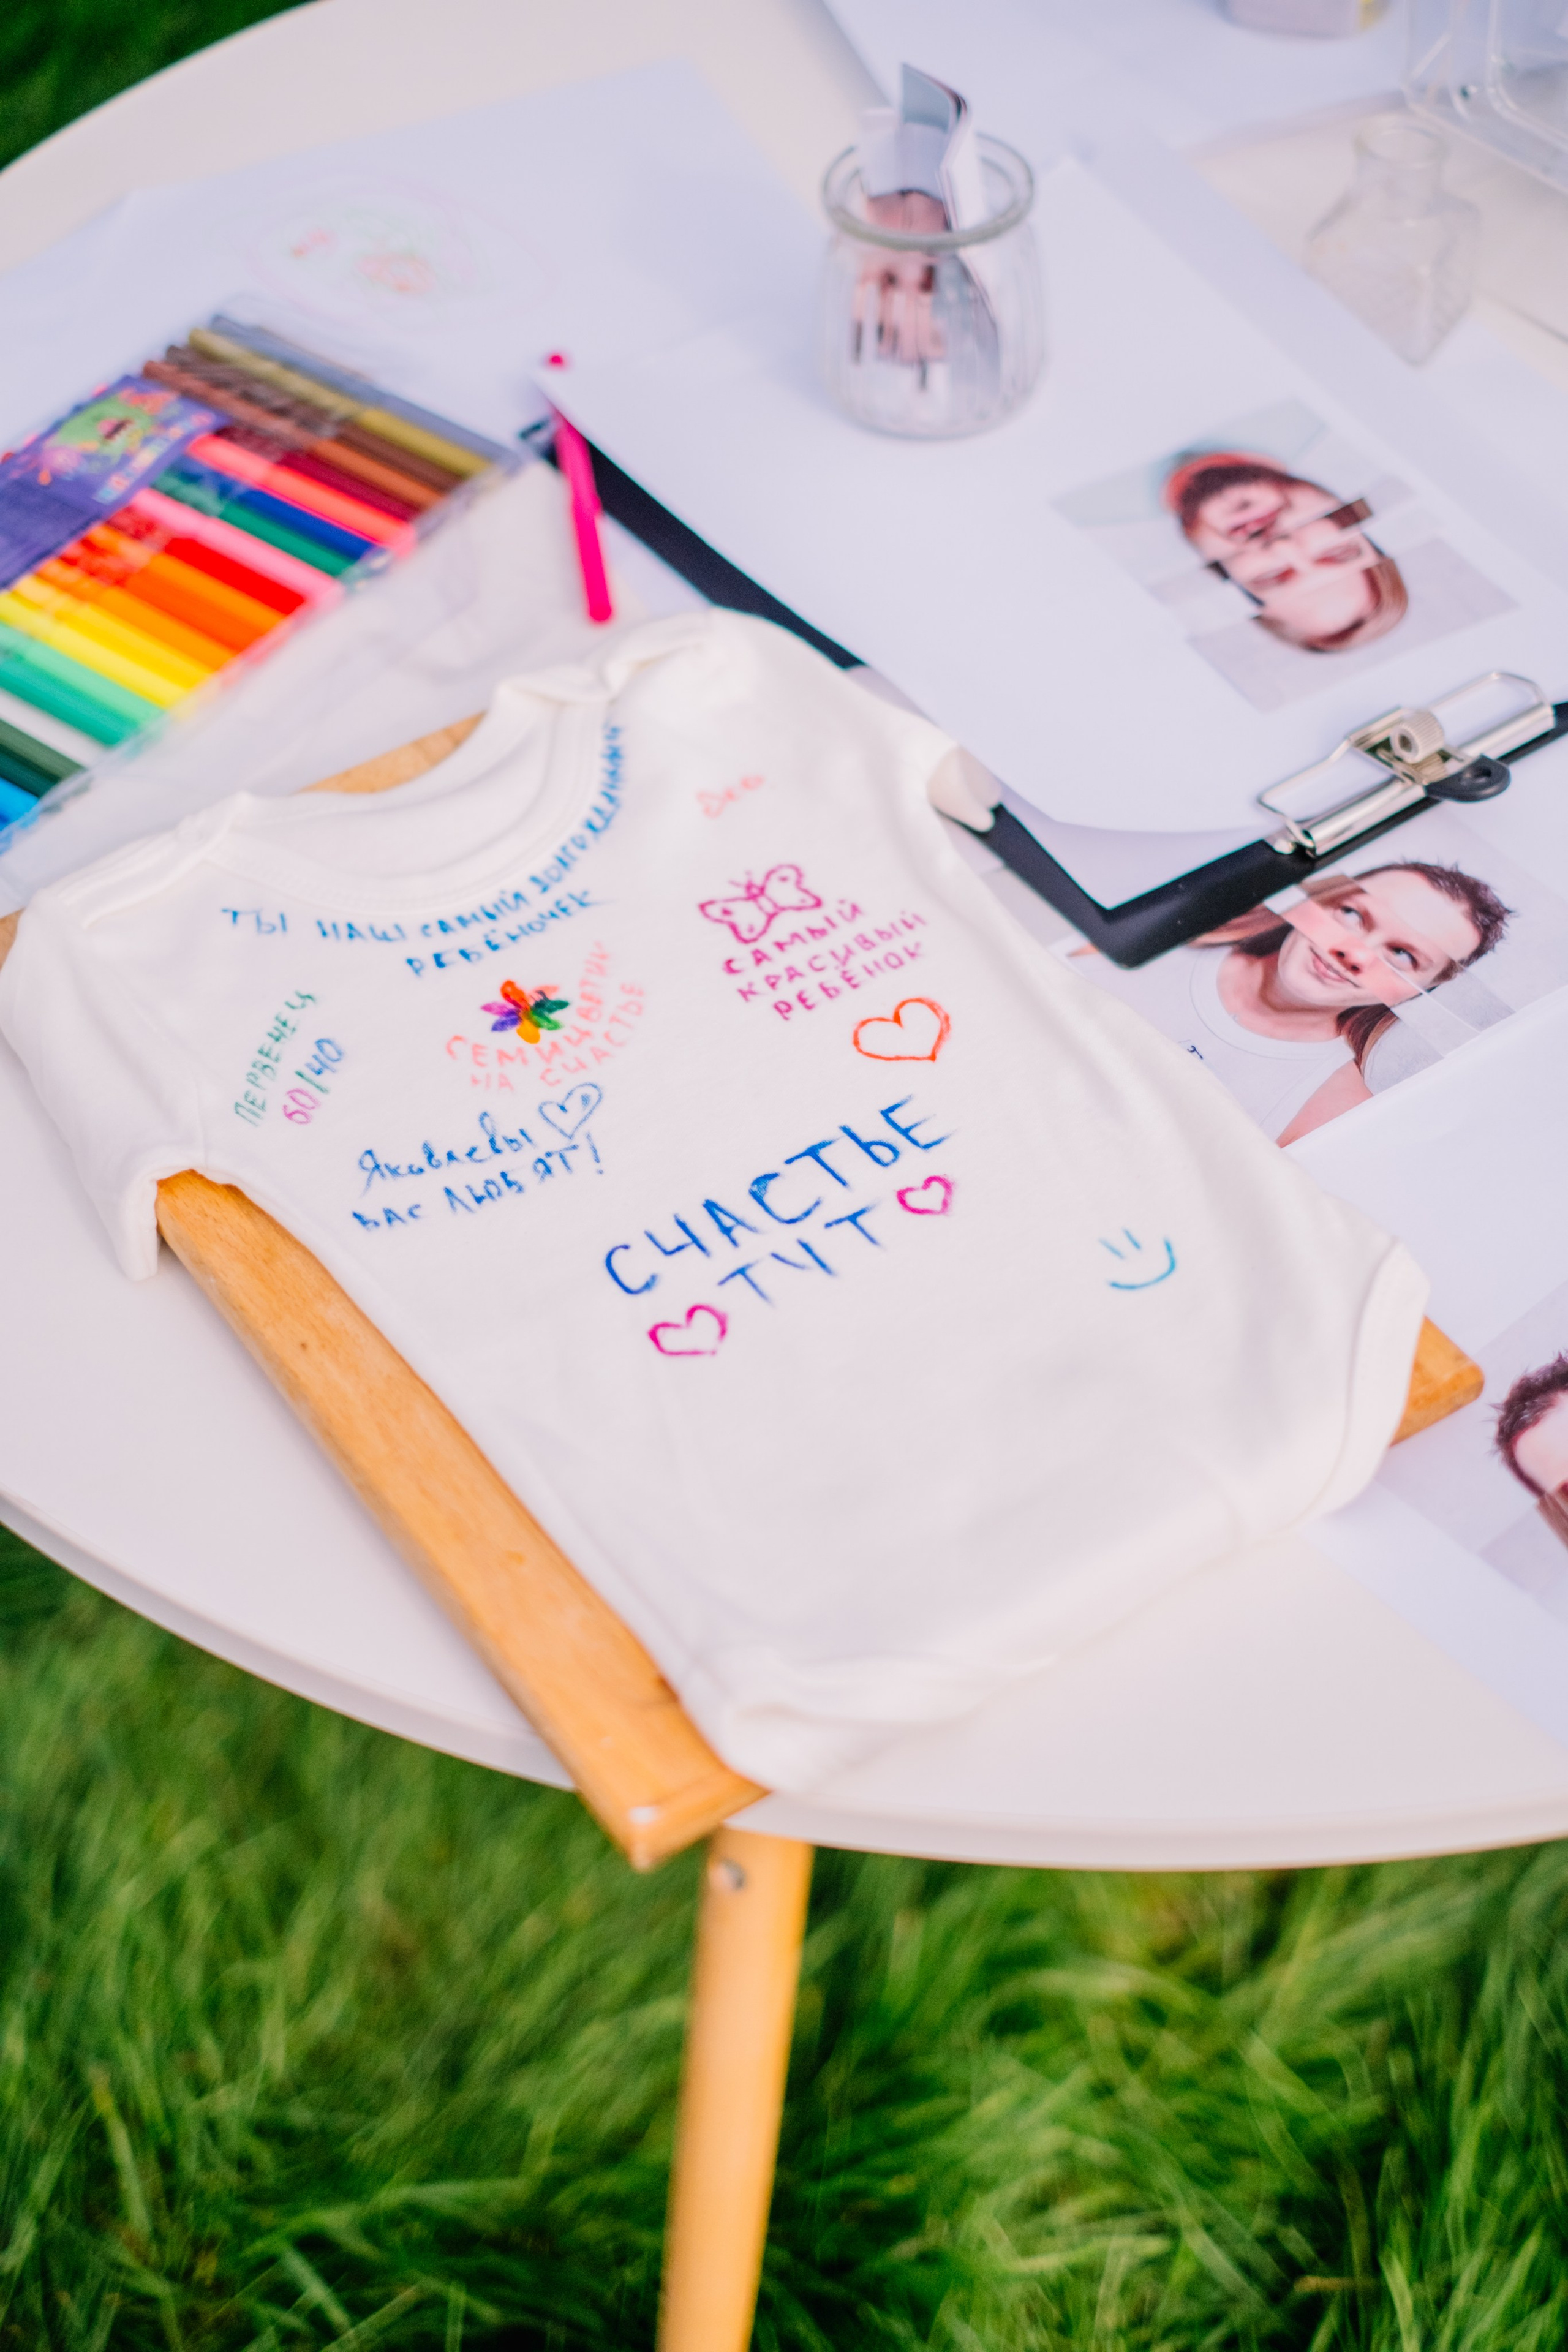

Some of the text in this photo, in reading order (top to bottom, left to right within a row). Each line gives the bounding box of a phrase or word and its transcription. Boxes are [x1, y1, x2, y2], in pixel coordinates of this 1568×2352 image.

[222, 906, 288, 935] ТЫ
[316, 919, 407, 943] НАШ
[420, 889, 530, 937] САМЫЙ
[722, 899, 864, 976] САМЫЙ
[737, 910, 927, 1003] КРАСИВЫЙ
[234, 990, 318, 1127] ПЕРВЕНЕЦ
[282, 1037, 345, 1125] 60/40
[470, 981, 646, 1093] НА СЧАСТЬЕ
[605, 1093, 956, 1296] СЧАСТЬЕ
[717, 1198, 883, 1307] ТУТ
